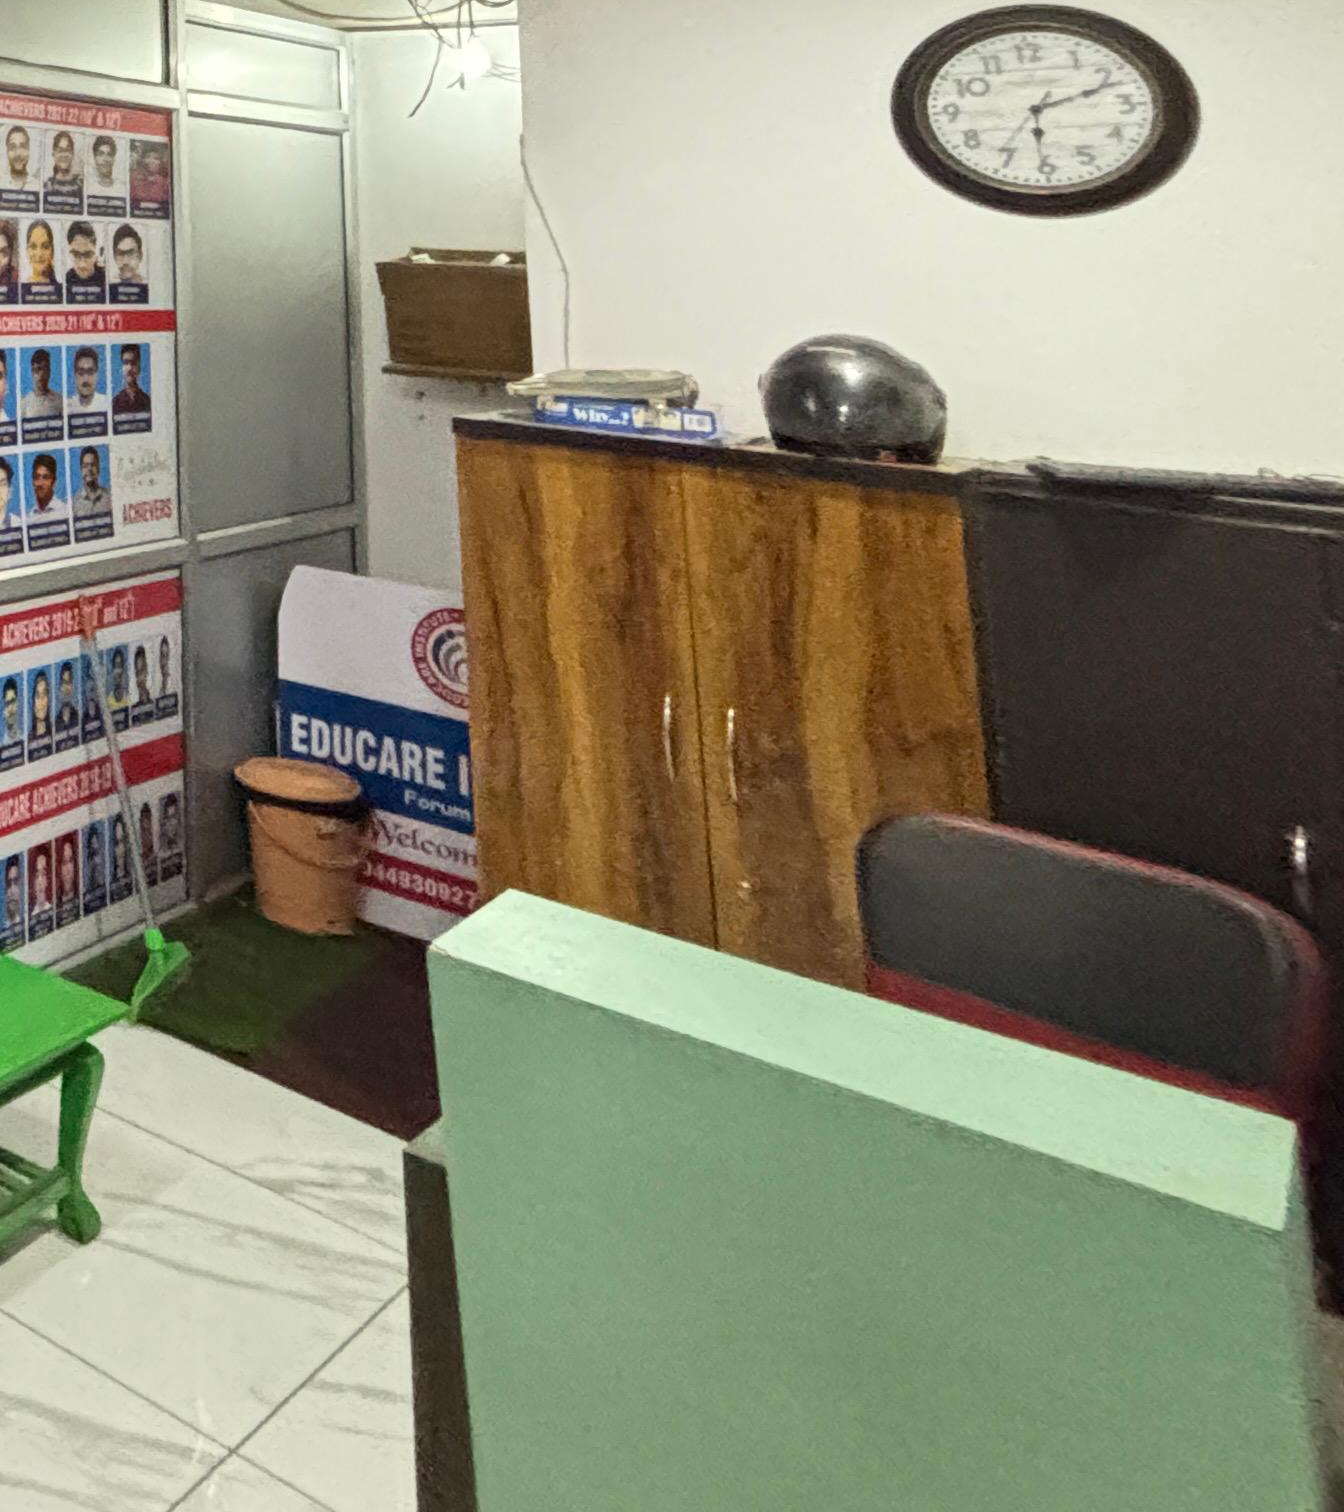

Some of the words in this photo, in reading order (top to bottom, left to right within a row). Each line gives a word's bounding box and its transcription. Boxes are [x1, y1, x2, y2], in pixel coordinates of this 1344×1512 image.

[1015, 43, 1042, 64] 12
[1068, 50, 1080, 70] 1
[980, 55, 1003, 75] 11
[957, 77, 990, 98] 10
[941, 102, 961, 123] 9
[1116, 93, 1136, 115] 3
[964, 129, 981, 150] 8
[998, 147, 1018, 168] 7
[1075, 146, 1097, 166] 5
[122, 498, 173, 525] ACHIEVERS
[290, 713, 446, 790] EDUCARE
[404, 789, 472, 822] Forum
